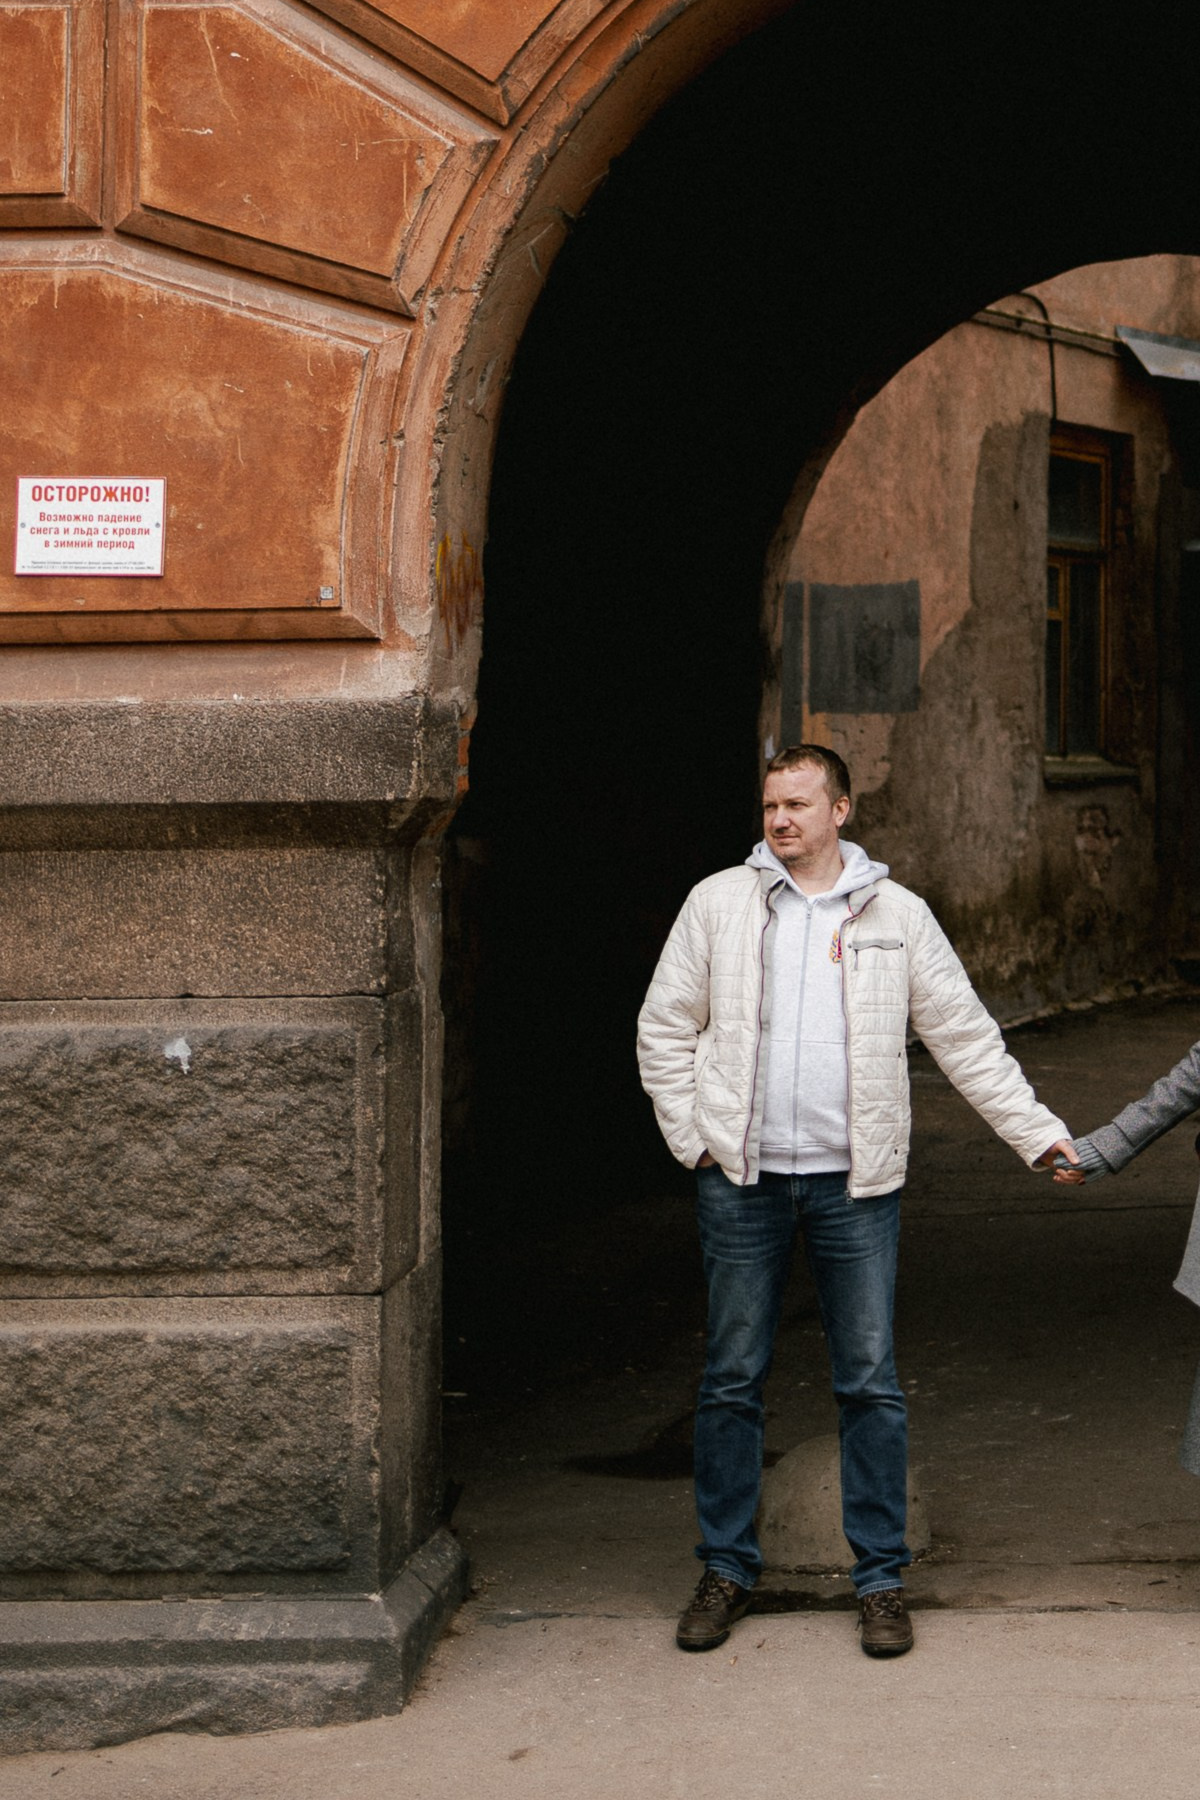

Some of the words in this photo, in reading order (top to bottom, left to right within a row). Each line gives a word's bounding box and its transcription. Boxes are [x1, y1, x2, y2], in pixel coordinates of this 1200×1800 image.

[31, 485, 150, 503] ОСТОРОЖНО!
[39, 512, 94, 523] Возможно
[97, 514, 142, 524] падение
[29, 526, 60, 535] снега
[63, 527, 70, 535] и
[73, 527, 99, 536] льда
[102, 527, 109, 535] с
[112, 527, 150, 537] кровли
[44, 540, 50, 548] в
[53, 538, 93, 548] зимний
[97, 540, 135, 550] период
